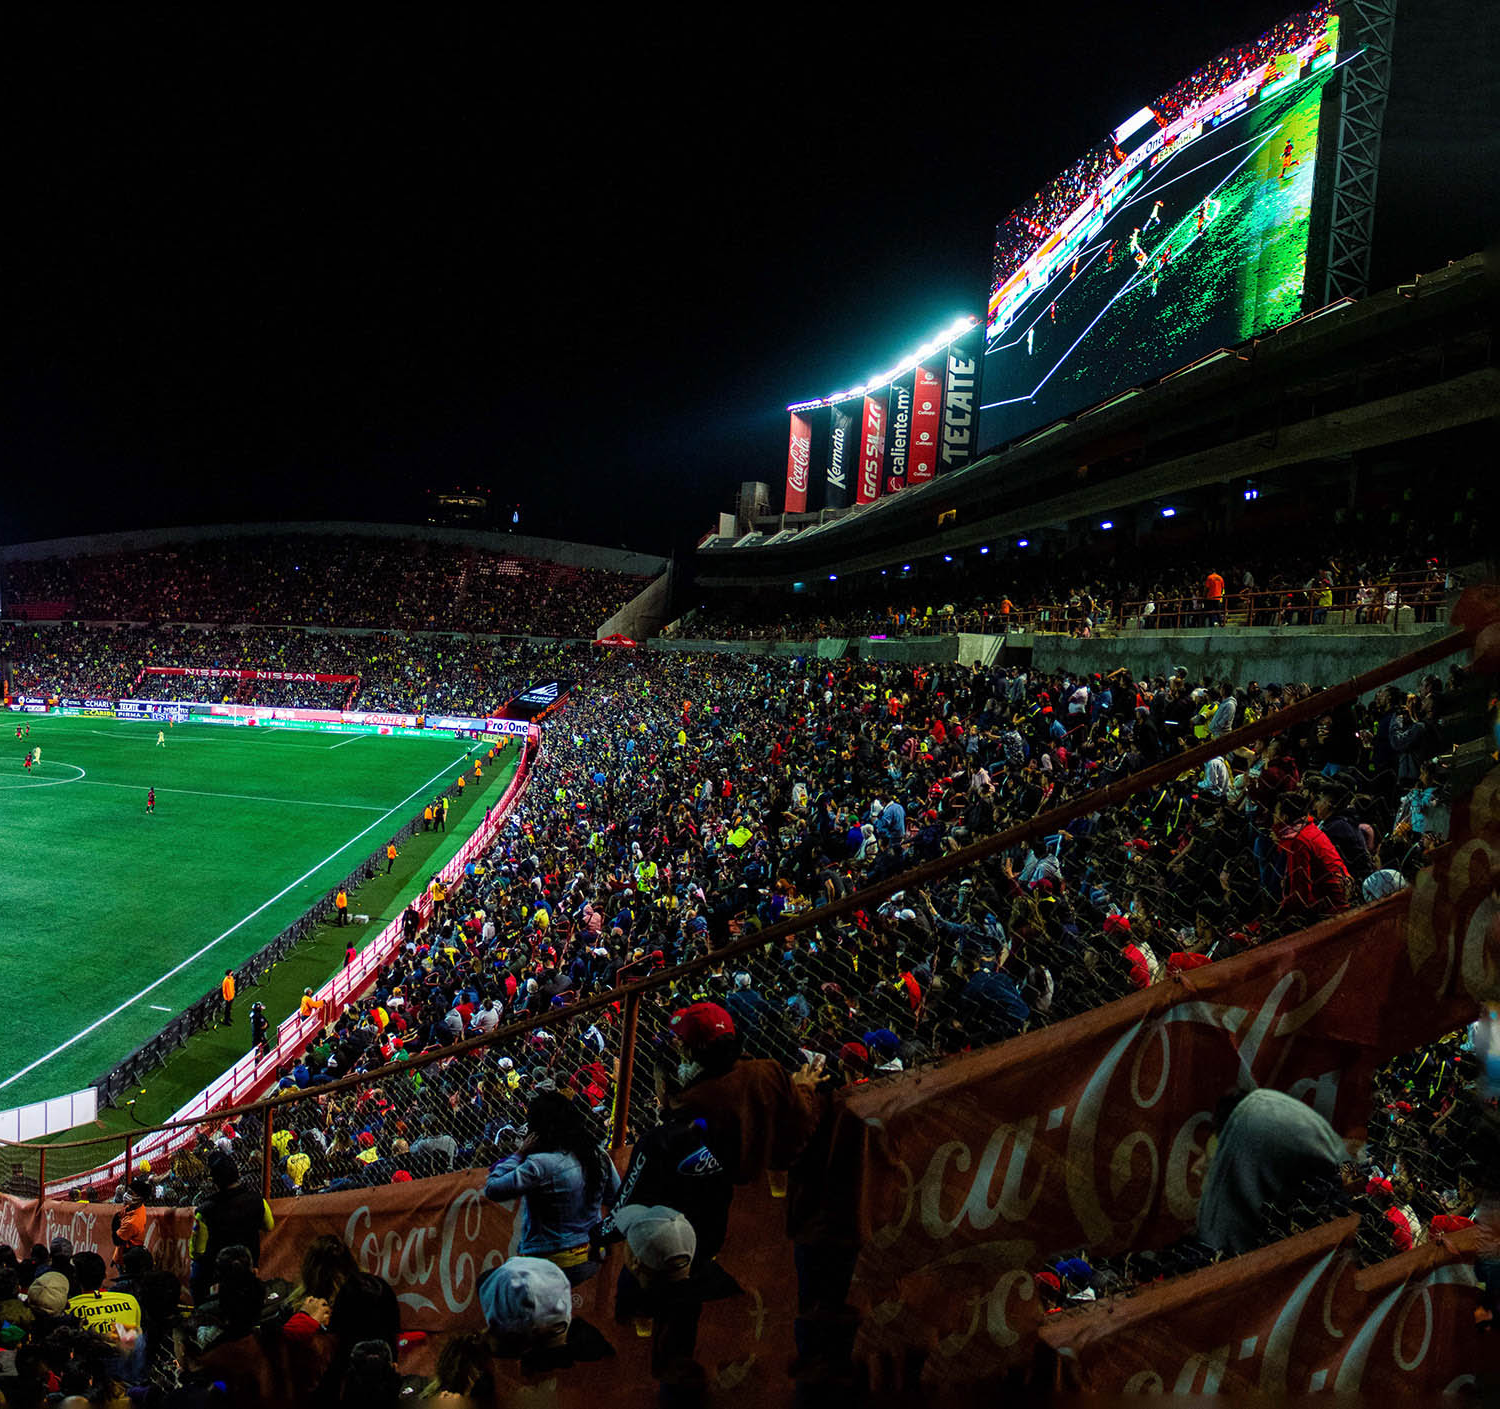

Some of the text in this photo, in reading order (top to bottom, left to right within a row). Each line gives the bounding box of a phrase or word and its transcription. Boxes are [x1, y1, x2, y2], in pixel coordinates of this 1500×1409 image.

[941, 353, 976, 465] TECATE
[891, 385, 910, 476] caliente.mx
[863, 456, 877, 498] GAS
[184, 668, 316, 681] NISSAN NISSAN
[75, 1300, 133, 1319] Corona
